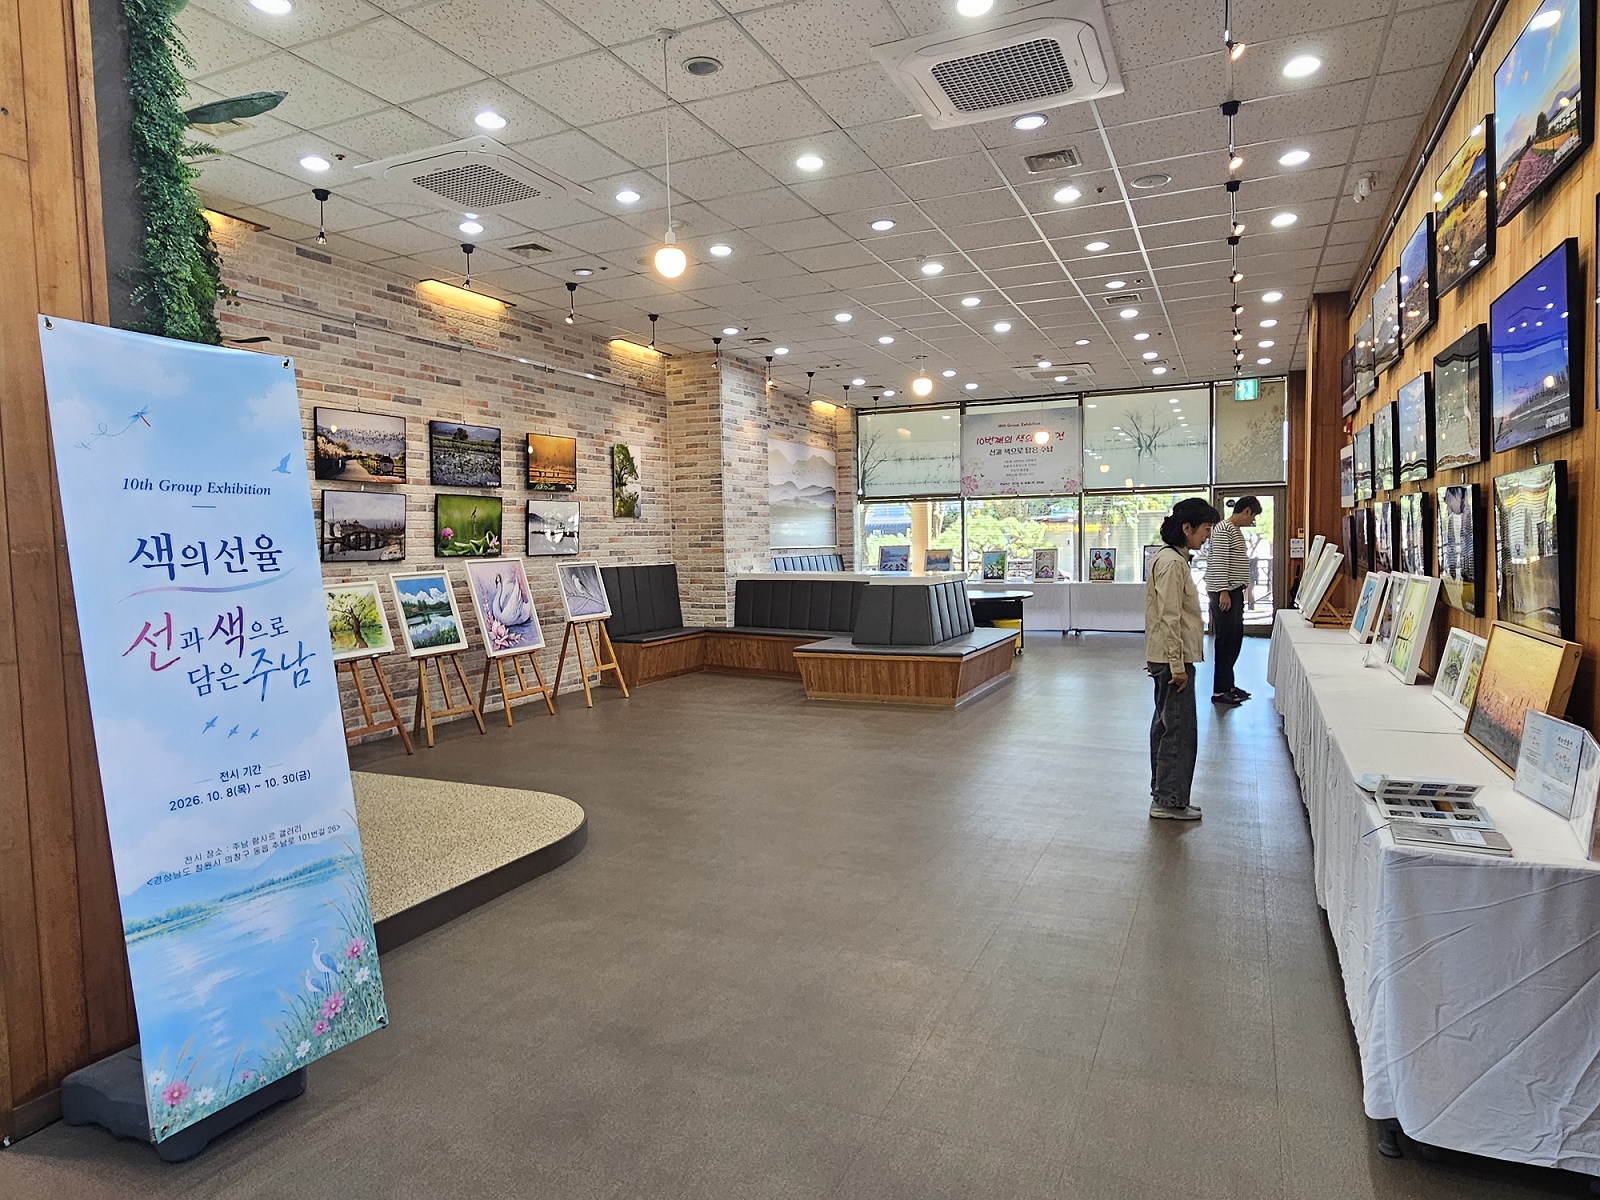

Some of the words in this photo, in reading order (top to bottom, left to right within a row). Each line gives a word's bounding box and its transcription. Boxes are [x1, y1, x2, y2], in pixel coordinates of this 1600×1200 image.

[122, 477, 154, 491] 10th
[158, 479, 202, 496] Group
[206, 481, 271, 496] Exhibition
[187, 662, 240, 697] 담은
[242, 640, 316, 702] 주남
[219, 771, 239, 783] 전시
[242, 764, 262, 777] 기간
[169, 795, 204, 811] 2026.
[206, 790, 223, 803] 10.
[226, 783, 251, 798] 8(목)
[264, 777, 280, 789] 10.
[282, 769, 311, 785] 30(금)
